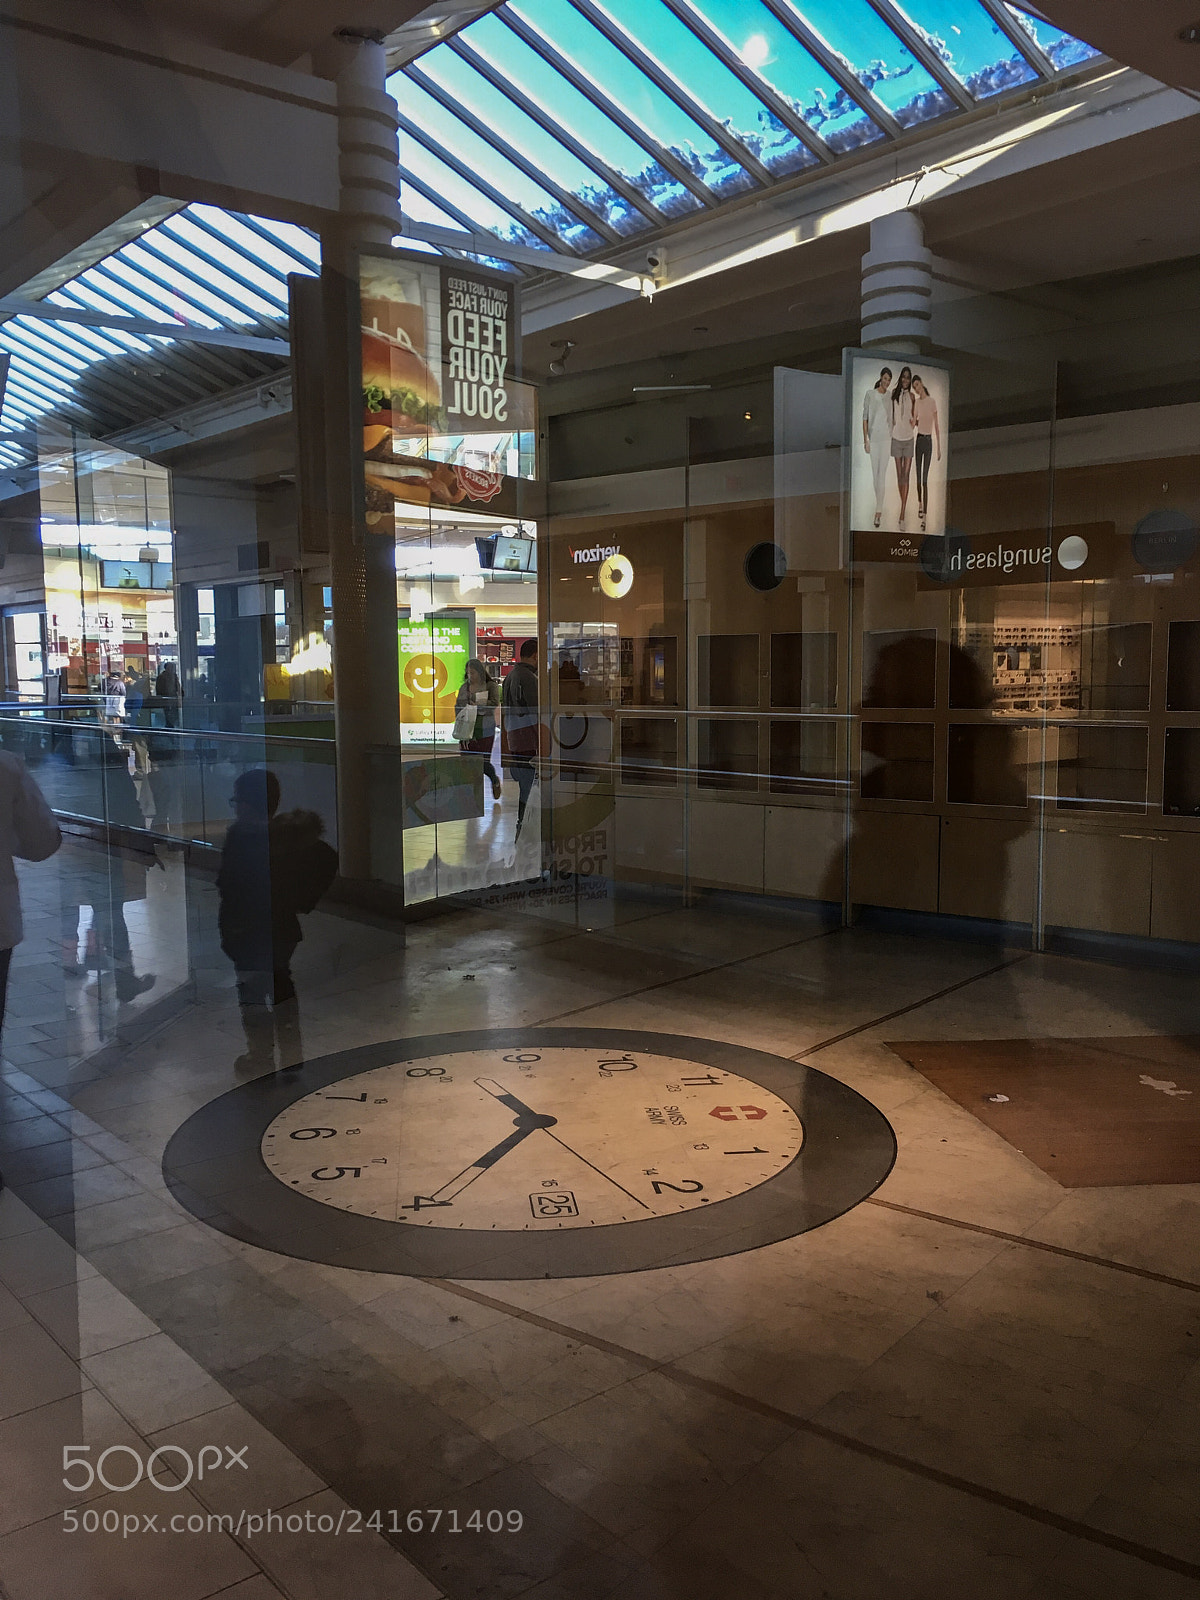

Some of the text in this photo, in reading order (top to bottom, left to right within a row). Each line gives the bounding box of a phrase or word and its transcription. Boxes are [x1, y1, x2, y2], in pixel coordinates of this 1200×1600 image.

[597, 1055, 638, 1072] 10
[406, 1067, 446, 1078] 8
[680, 1074, 723, 1086] 11
[326, 1092, 367, 1102] 7
[644, 1107, 667, 1125] ARMY
[663, 1105, 687, 1126] SWISS
[289, 1127, 338, 1140] 6
[311, 1166, 361, 1181] 5
[651, 1180, 704, 1194] 2
[537, 1195, 573, 1215] 25
